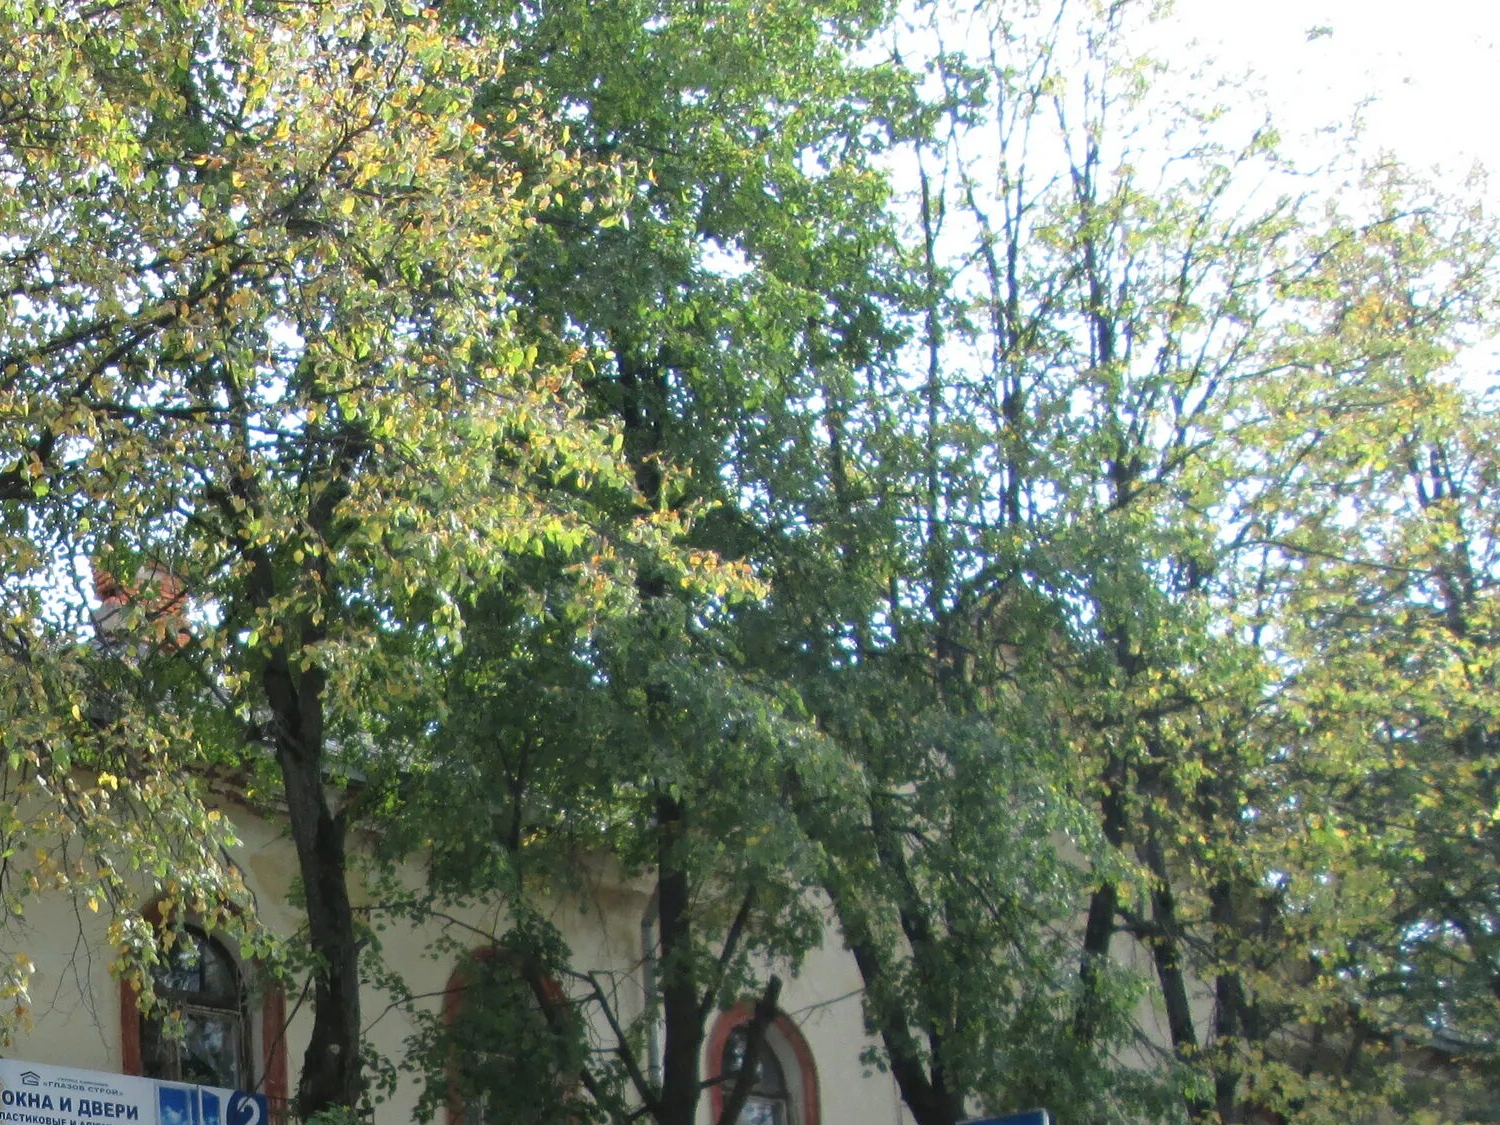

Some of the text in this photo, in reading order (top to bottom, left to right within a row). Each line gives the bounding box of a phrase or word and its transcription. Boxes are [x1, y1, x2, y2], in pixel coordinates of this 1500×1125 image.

[1, 1089, 139, 1121] ОКНА И ДВЕРИ
